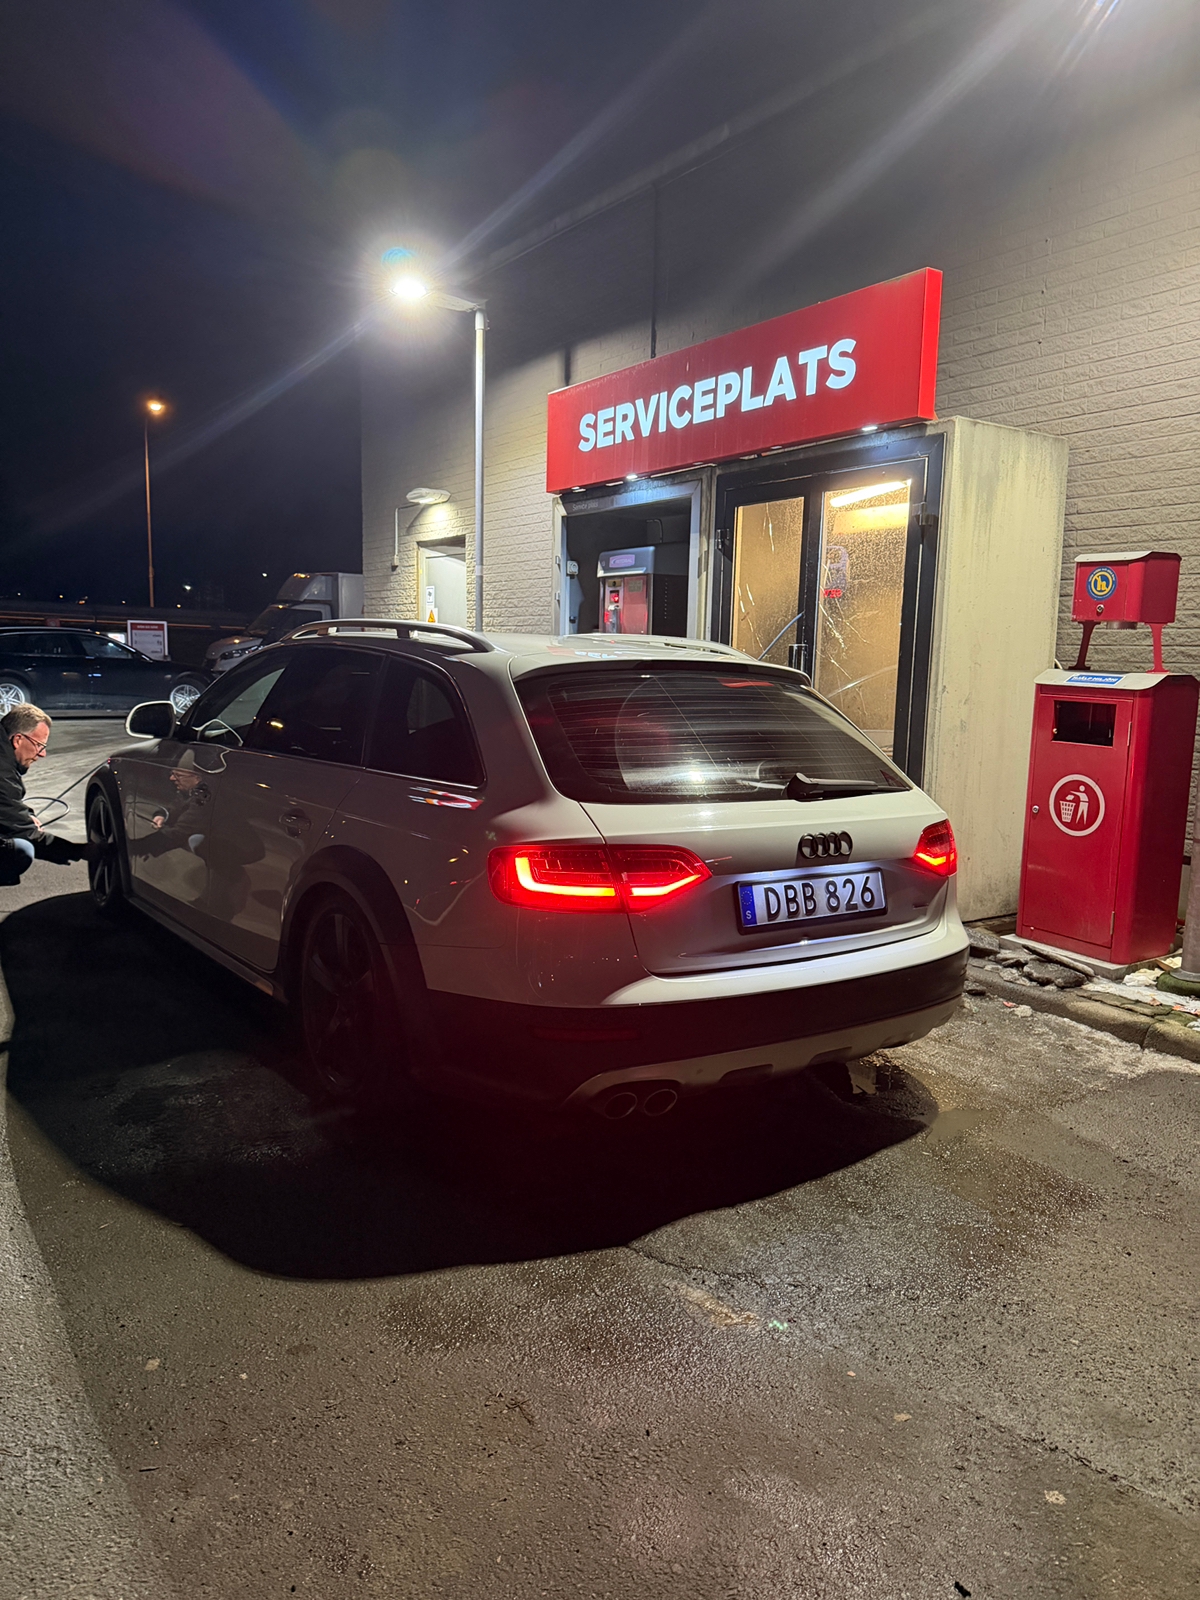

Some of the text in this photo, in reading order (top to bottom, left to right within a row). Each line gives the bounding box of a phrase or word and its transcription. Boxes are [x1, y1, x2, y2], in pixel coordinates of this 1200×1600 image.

[578, 338, 857, 452] SERVICEPLATS
[746, 910, 752, 920] S
[764, 875, 875, 922] DBB 826
